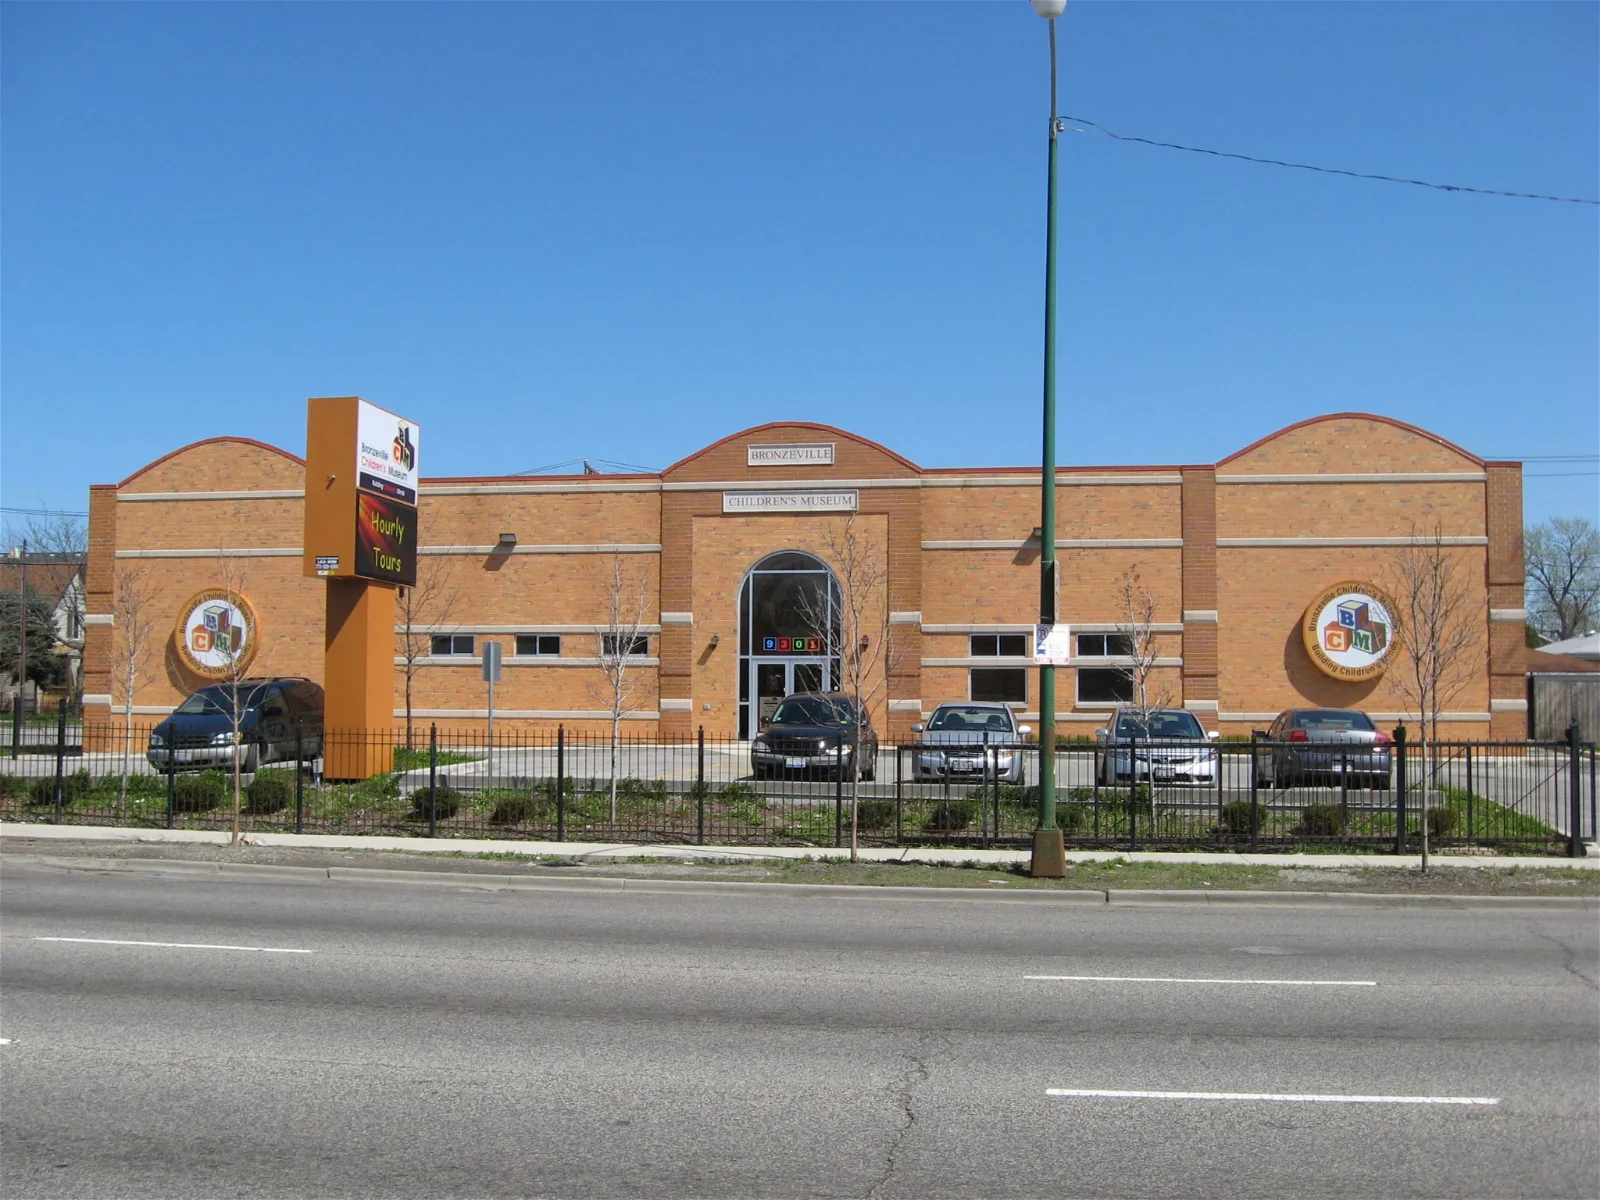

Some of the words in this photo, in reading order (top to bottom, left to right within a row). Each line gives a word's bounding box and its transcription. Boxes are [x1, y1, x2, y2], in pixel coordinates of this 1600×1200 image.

[361, 442, 388, 461] Bronzeville
[751, 449, 831, 460] BRONZEVILLE
[388, 465, 408, 481] Museum
[728, 496, 797, 507] CHILDREN'S
[800, 496, 852, 506] MUSEUM
[371, 511, 404, 544] Hourly
[373, 546, 401, 572] Tours
[1308, 592, 1336, 632] Bronzeville
[1336, 585, 1378, 599] Children's
[1340, 609, 1355, 627] B
[193, 634, 206, 649] C
[765, 639, 818, 649] 9301
[1327, 632, 1342, 648] C
[1354, 632, 1370, 651] M
[1312, 645, 1338, 673] Building
[1340, 663, 1382, 676] Children's
